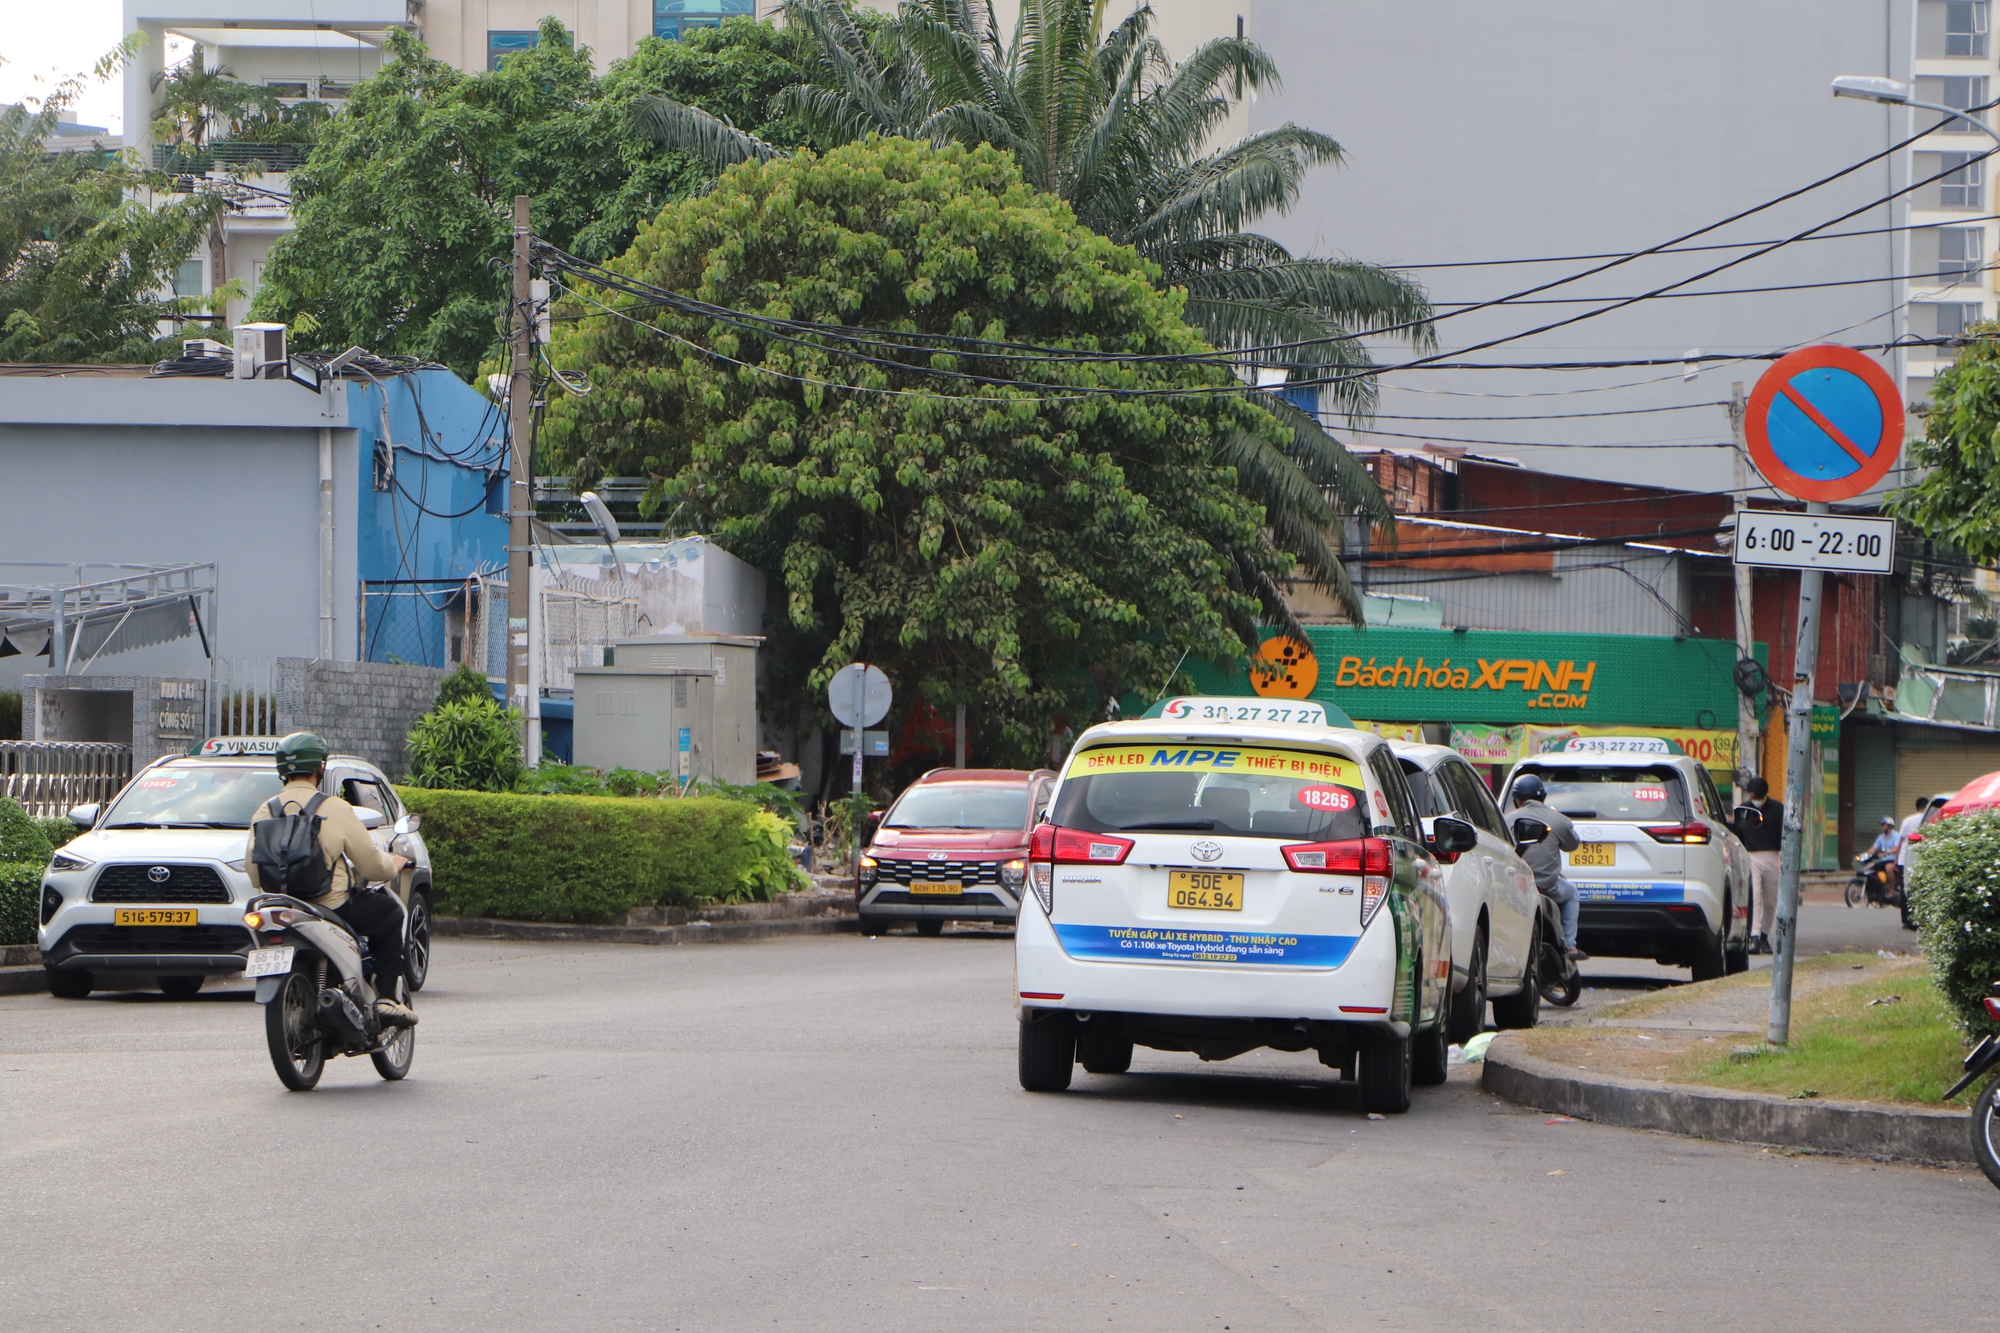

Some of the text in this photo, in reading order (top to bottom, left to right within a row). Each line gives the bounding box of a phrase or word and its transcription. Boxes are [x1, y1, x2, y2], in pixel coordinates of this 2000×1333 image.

[1745, 527, 1795, 551] 6:00
[1818, 532, 1881, 557] 22:00
[1469, 658, 1597, 692] XANH
[1527, 693, 1588, 709] .COM
[1268, 708, 1291, 723] 27
[1297, 709, 1322, 724] 27
[1629, 742, 1645, 752] 27
[1649, 742, 1665, 753] 27
[1088, 749, 1342, 778] ĐÈN LED MPE THIẾT BỊ ĐIỆN
[1304, 789, 1350, 809] 18265
[1634, 790, 1665, 800] 20154
[1582, 844, 1602, 854] 51G
[1574, 854, 1610, 865] 690.21
[1190, 874, 1223, 890] 50E
[1176, 891, 1234, 908] 064.94
[122, 911, 191, 923] 51G-579.37
[1109, 928, 1138, 938] TUYỂN
[1160, 931, 1175, 940] LÁI
[1176, 933, 1187, 941] XE
[1189, 933, 1224, 943] HYBRID
[1230, 935, 1249, 944] THU
[1251, 935, 1277, 947] NHẬP
[1278, 937, 1298, 946] CAO
[1120, 940, 1132, 948] Có
[1134, 941, 1156, 949] 1.106
[1167, 942, 1195, 952] Toyota
[1196, 943, 1224, 953] Hybrid
[1225, 944, 1247, 955] đang
[1264, 946, 1284, 956] sàng
